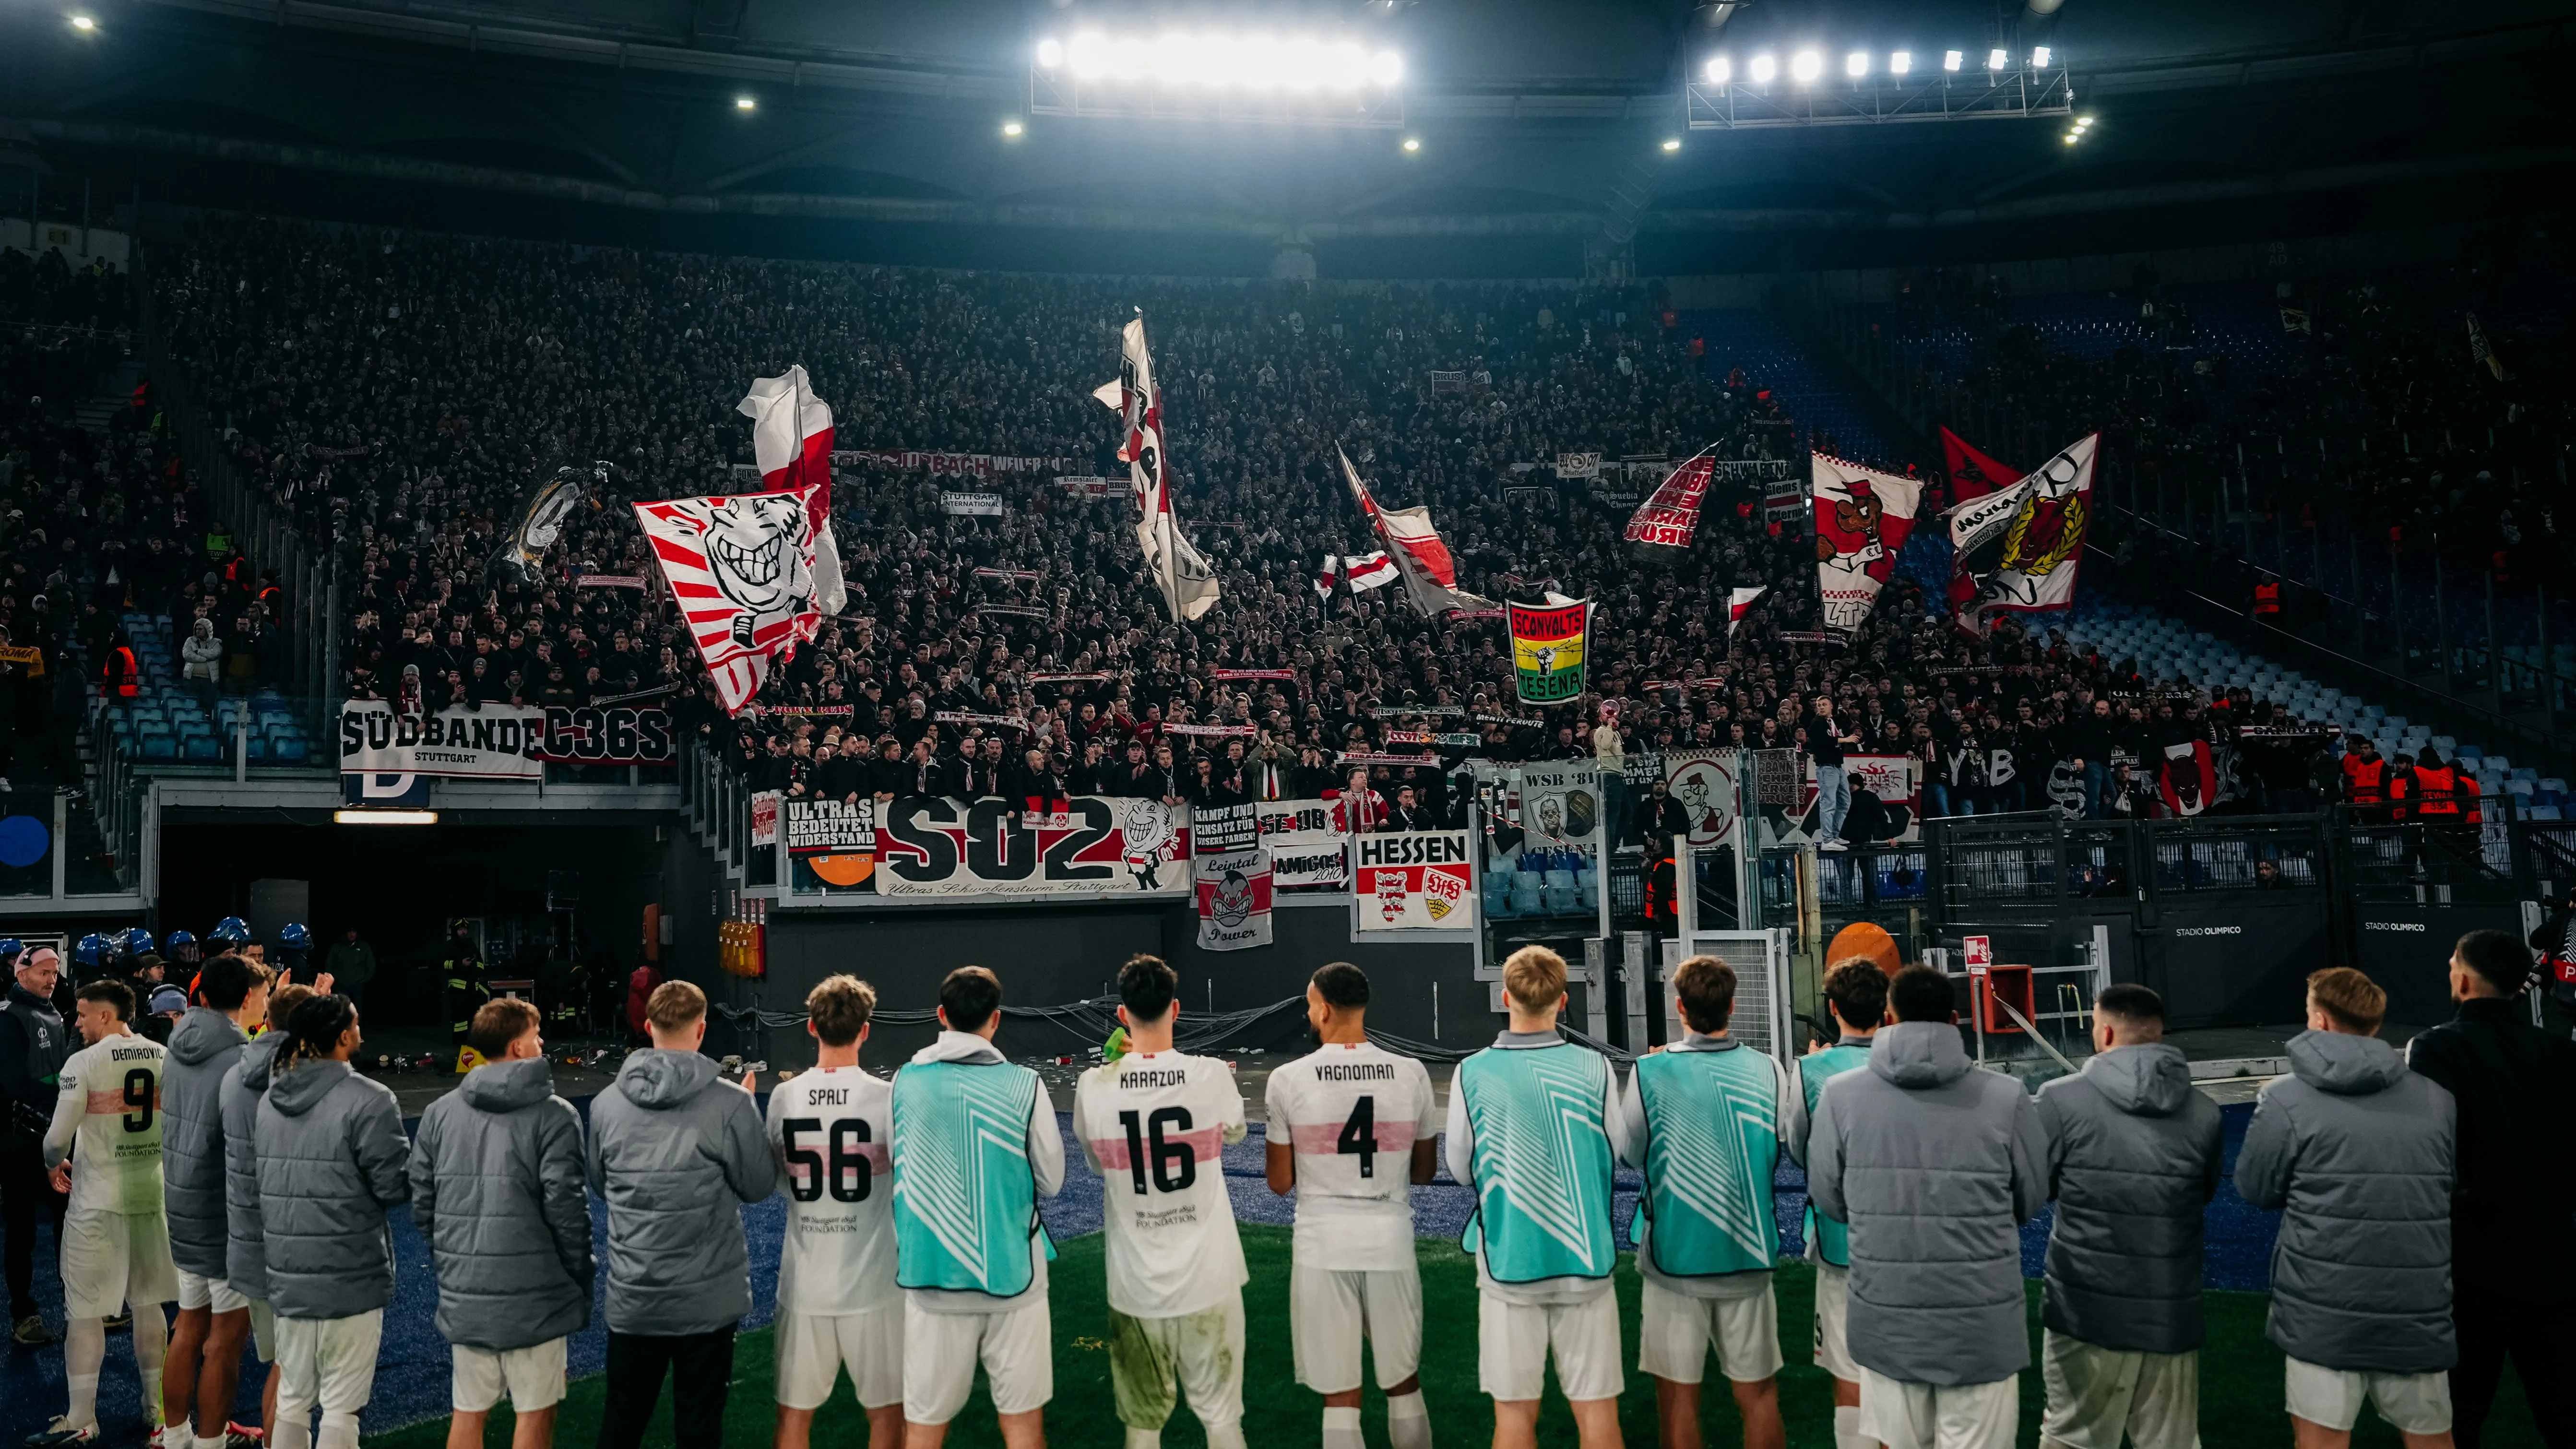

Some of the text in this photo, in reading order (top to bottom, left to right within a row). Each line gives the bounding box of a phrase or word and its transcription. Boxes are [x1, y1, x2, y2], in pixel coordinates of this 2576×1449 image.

[993, 456, 1041, 471] WEILER
[1587, 453, 1599, 467] 07
[1515, 610, 1581, 637] SCONVOLTS
[1520, 671, 1581, 697] CESENA
[1476, 713, 1505, 723] MENTI
[342, 710, 540, 760] SÜDBANDE
[1390, 731, 1419, 742] CC97
[415, 752, 476, 763] STUTTGART
[1525, 773, 1565, 787] WSB
[1623, 766, 1661, 778] MMER
[788, 798, 873, 821] ULTRAS
[1195, 803, 1254, 822] KAMPF UND
[788, 818, 873, 835] BEDEUTET
[1195, 816, 1255, 835] EINSATZ FÜR
[1260, 808, 1326, 835] SE 08
[788, 831, 876, 847] WIDERSTAND
[1197, 831, 1256, 845] UNSERE FARBEN!
[1361, 836, 1466, 865] HESSEN
[1205, 853, 1259, 872] Leintal
[1312, 867, 1342, 881] 2010
[888, 881, 1130, 894] Ultras Schwabensturm Stuttgart
[1208, 928, 1257, 941] Power
[2176, 926, 2241, 936] STADIO OLIMPICO
[2365, 922, 2425, 932] STADIO OLIMPICO
[1120, 1069, 1186, 1089] KARAZOR
[1315, 1064, 1395, 1081] VAGNOMAN
[122, 1068, 154, 1133] 9
[809, 1089, 850, 1105] SPALT
[1338, 1096, 1378, 1178] 4
[115, 1148, 161, 1158] FOUNDATION
[1119, 1105, 1195, 1195] 16
[783, 1118, 871, 1202] 56
[801, 1224, 857, 1233] FOUNDATION
[1136, 1214, 1197, 1228] FOUNDATION
